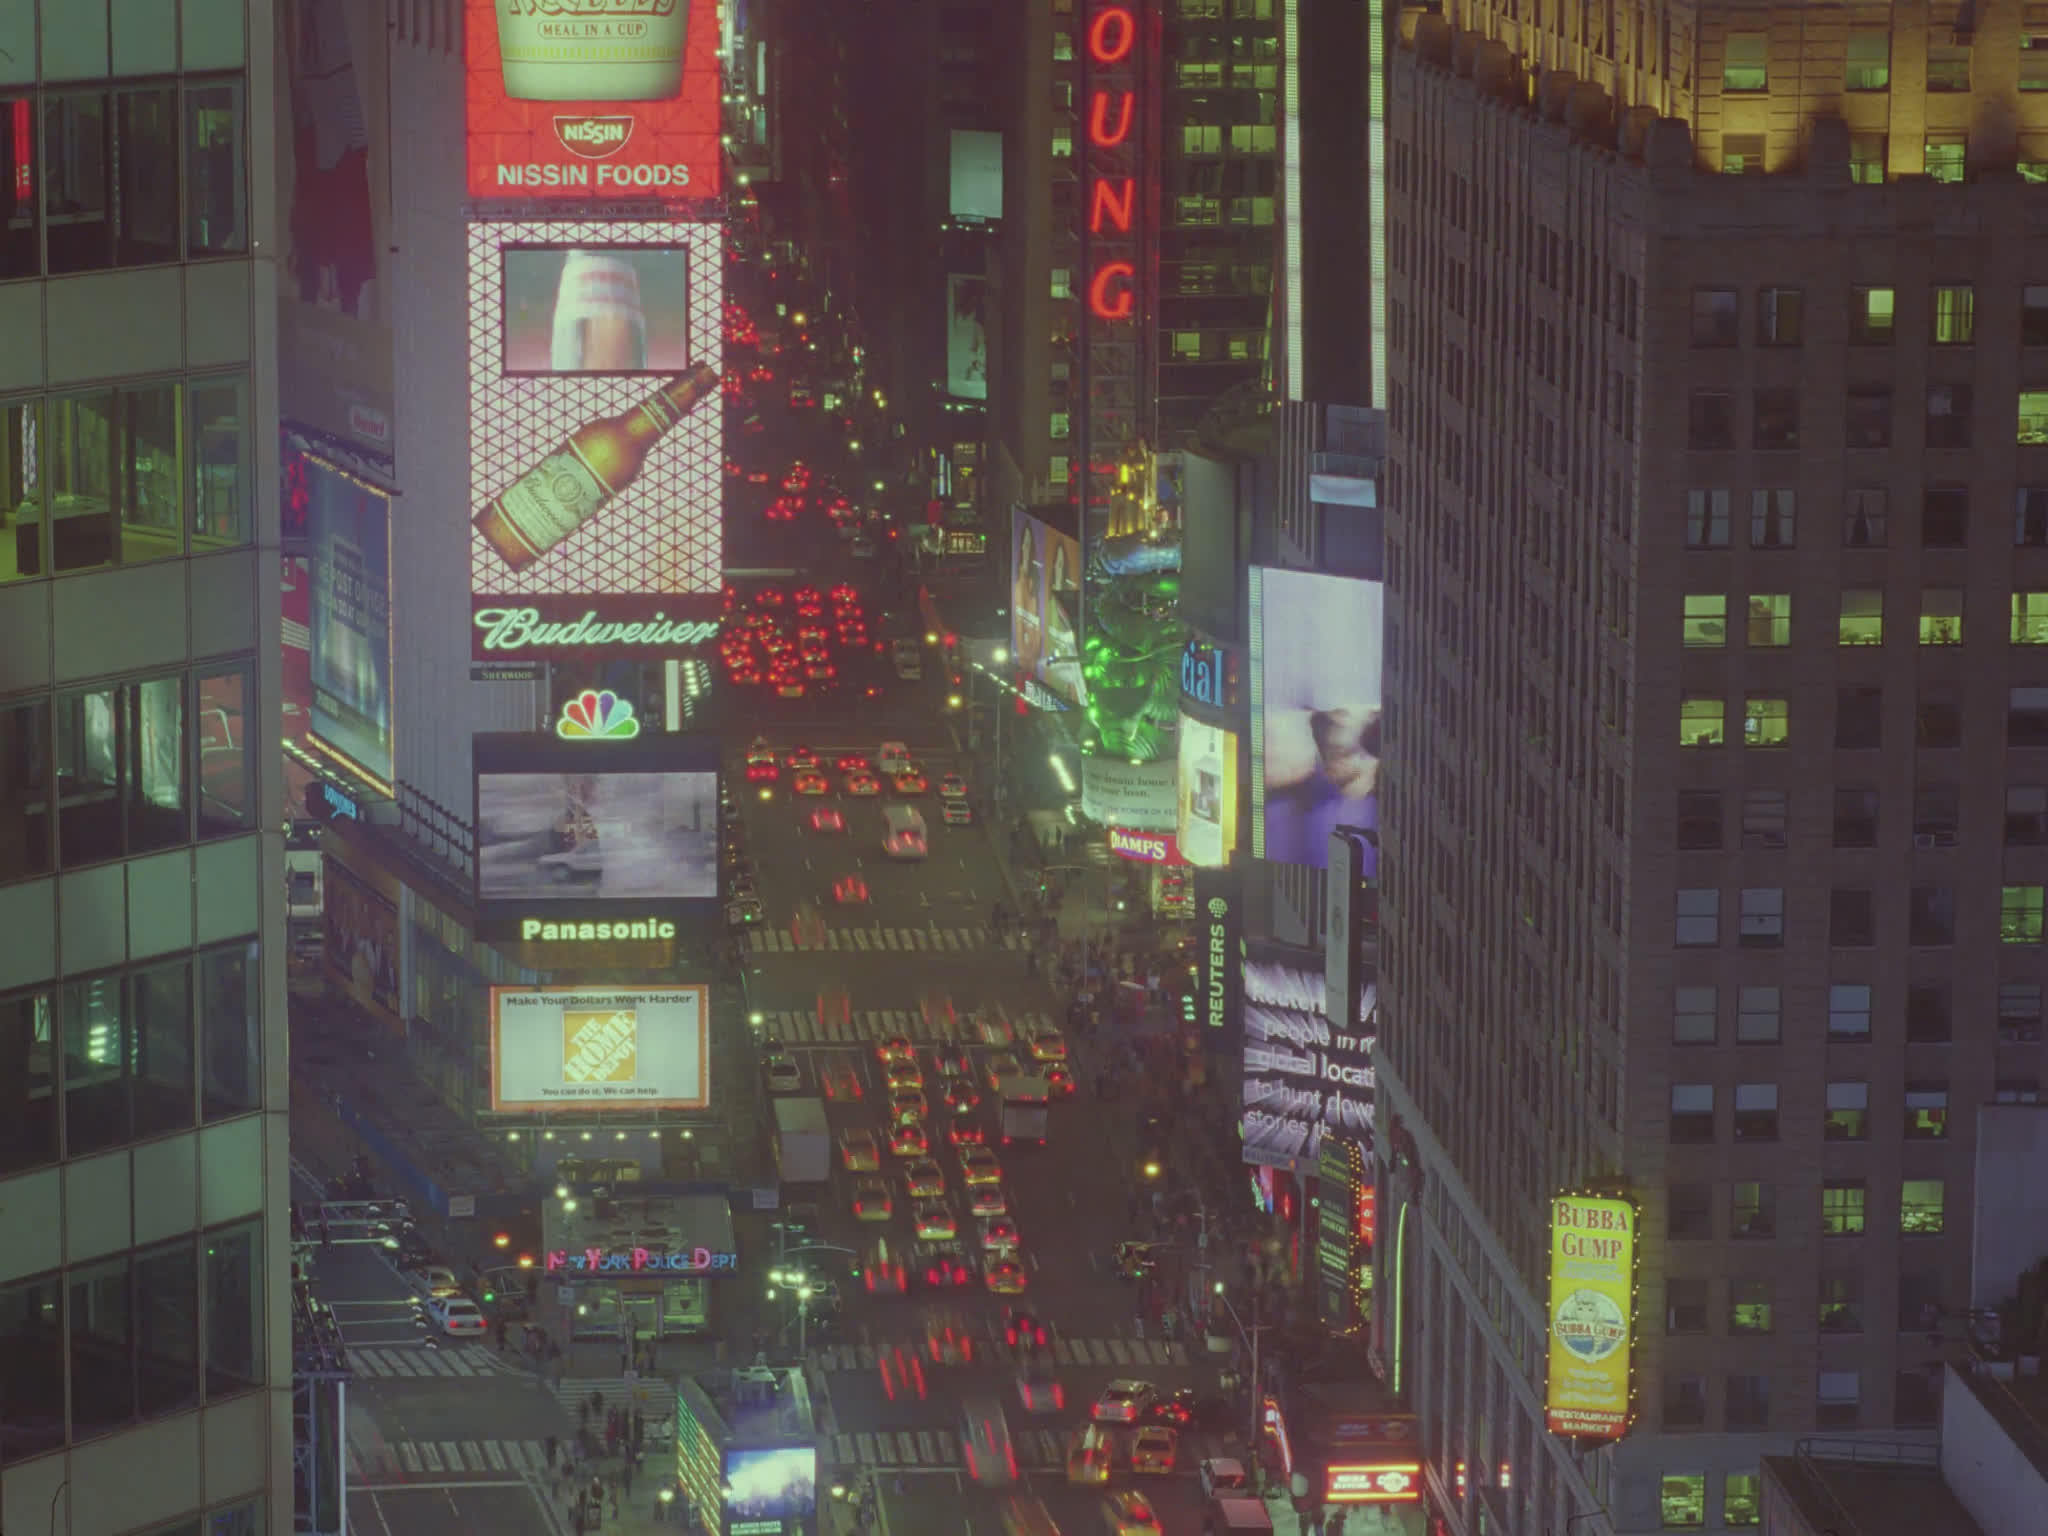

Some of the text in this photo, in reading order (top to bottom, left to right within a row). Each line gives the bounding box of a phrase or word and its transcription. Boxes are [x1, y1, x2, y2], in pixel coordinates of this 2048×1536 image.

[543, 23, 644, 37] MEAL IN A CUP
[563, 120, 624, 145] NISSIN
[497, 163, 690, 186] NISSIN FOODS
[474, 607, 719, 650] Budweiser
[522, 917, 676, 941] Panasonic
[1208, 923, 1225, 1027] REUTERS
[506, 994, 692, 1007] Make Your Dollars Work Harder
[564, 1010, 635, 1081] HOME
[592, 1038, 635, 1081] DEPOT
[1246, 1109, 1309, 1135] stories
[1557, 1201, 1628, 1233] BUBBA
[1561, 1232, 1624, 1259] GUMP
[585, 1248, 630, 1271] YORK
[633, 1247, 689, 1271] POLICE
[694, 1247, 737, 1270] DEPT
[1555, 1321, 1592, 1336] BUBBA
